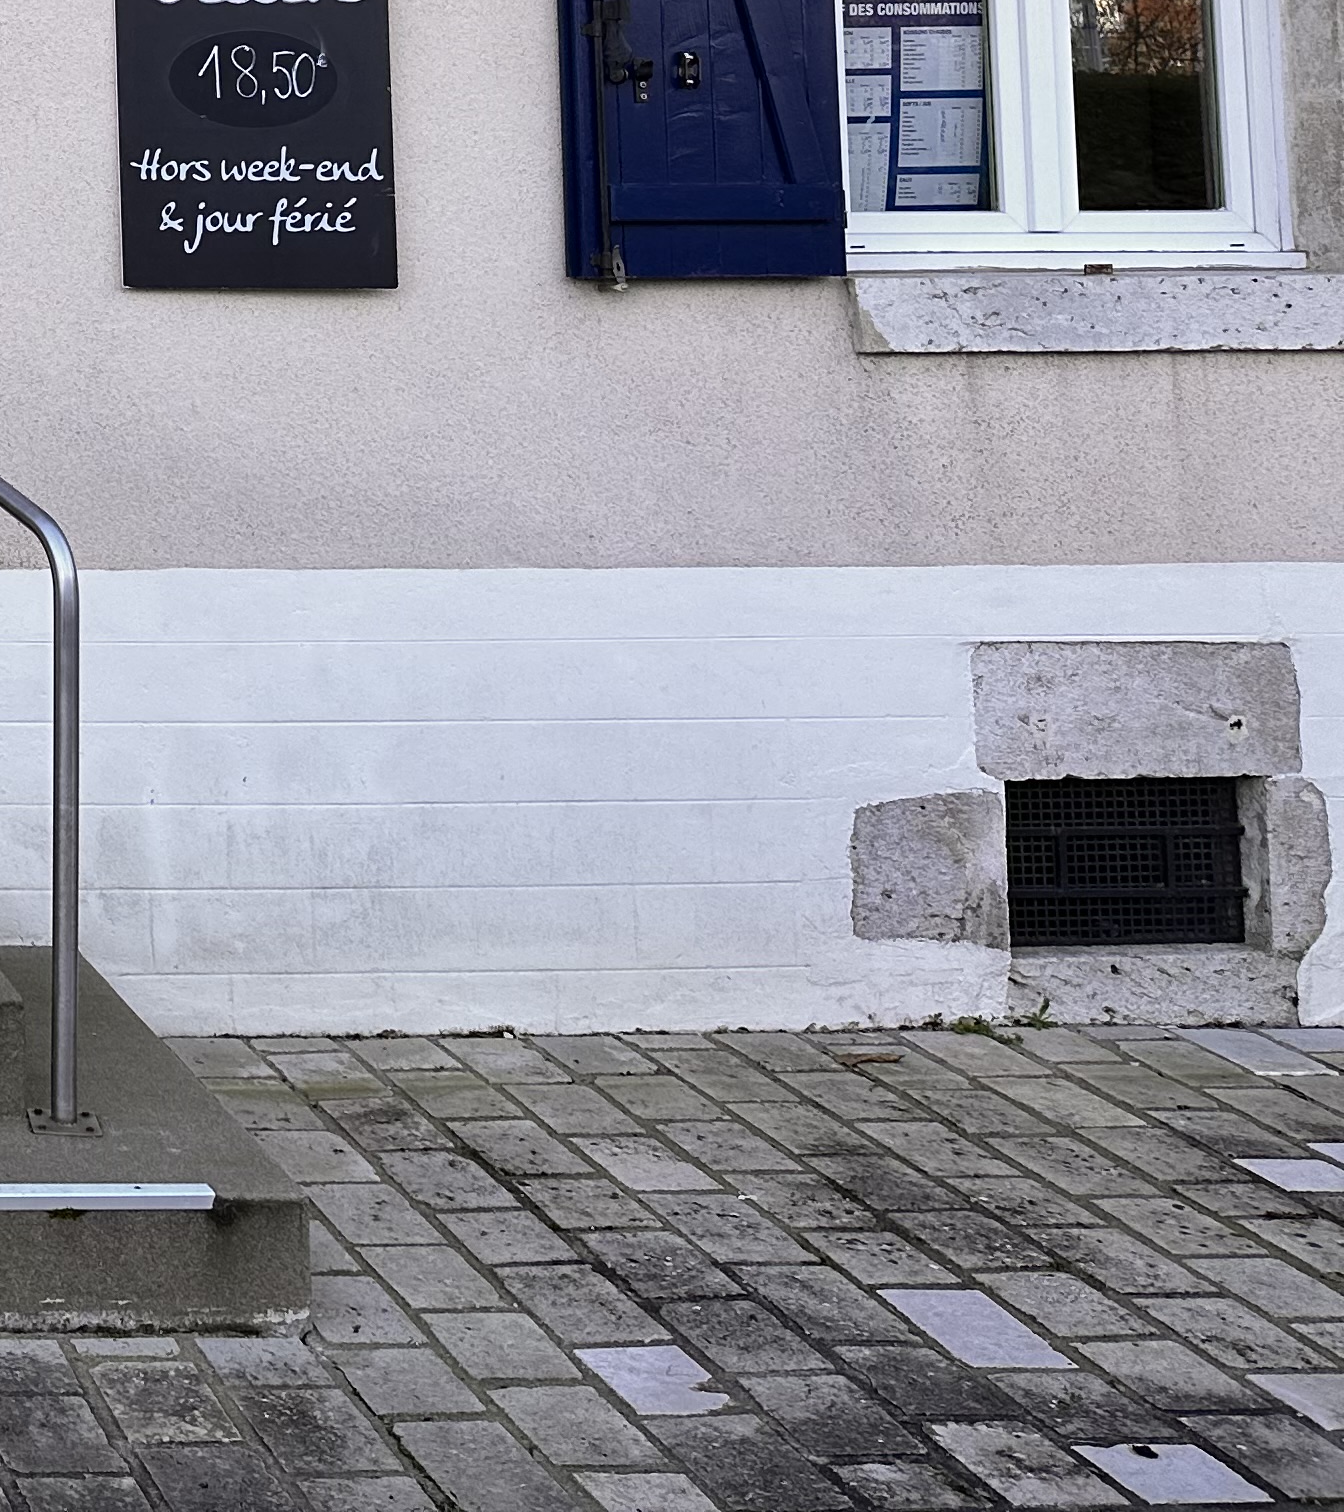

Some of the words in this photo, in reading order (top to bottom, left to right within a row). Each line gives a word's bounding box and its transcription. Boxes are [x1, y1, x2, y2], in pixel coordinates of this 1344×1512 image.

[849, 3, 873, 16] DES
[877, 2, 983, 15] CONSOMMATIONS
[130, 148, 211, 182] Hors
[220, 146, 384, 183] week-end
[158, 201, 183, 232] &
[184, 203, 263, 253] jour
[269, 198, 356, 245] férié
